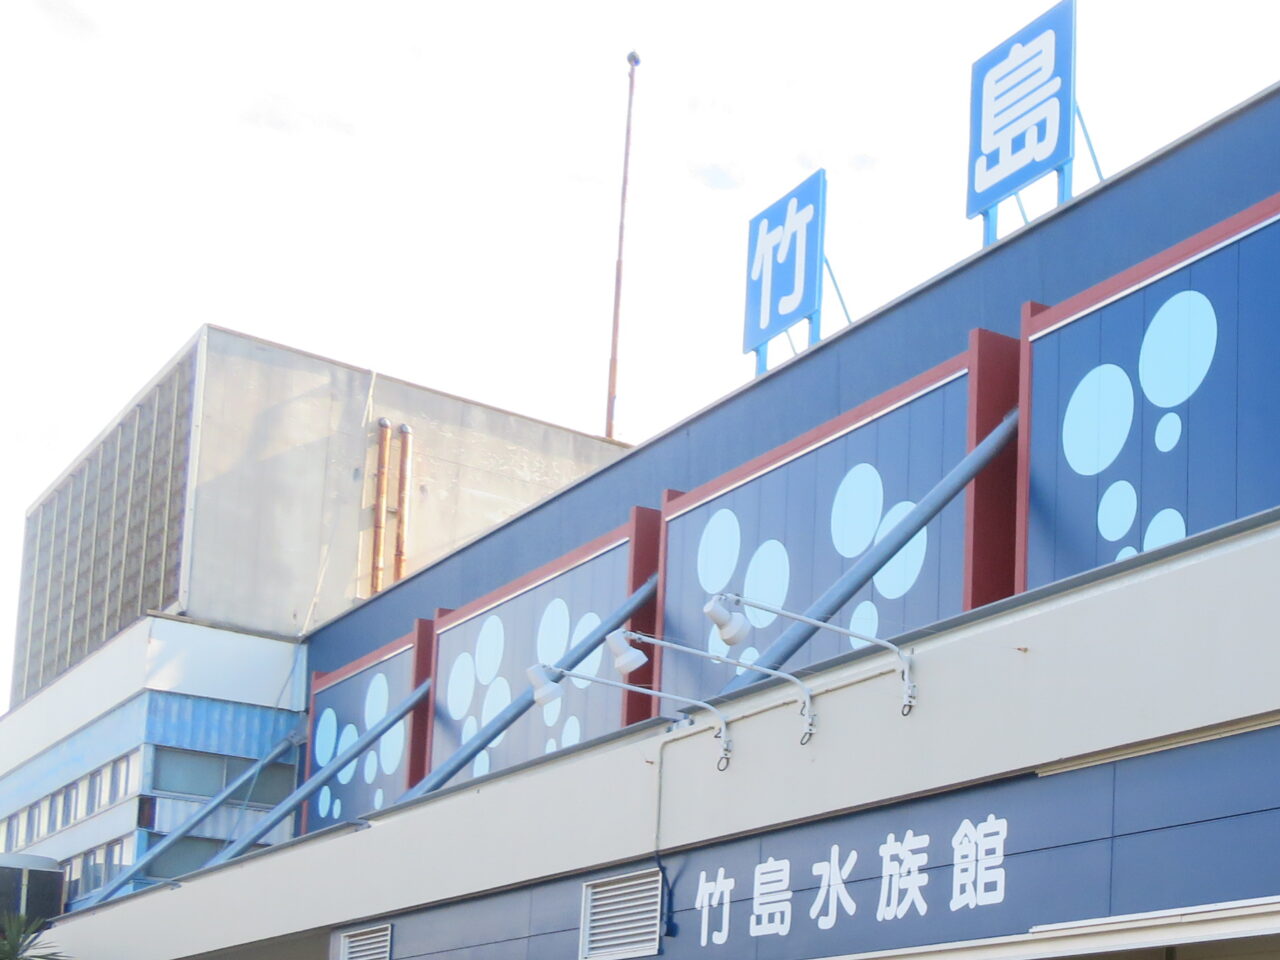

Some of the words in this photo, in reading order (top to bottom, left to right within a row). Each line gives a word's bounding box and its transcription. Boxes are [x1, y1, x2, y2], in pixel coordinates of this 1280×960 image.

[751, 197, 813, 329] 竹
[974, 28, 1063, 193] 島
[695, 812, 1008, 947] 竹島水族館
